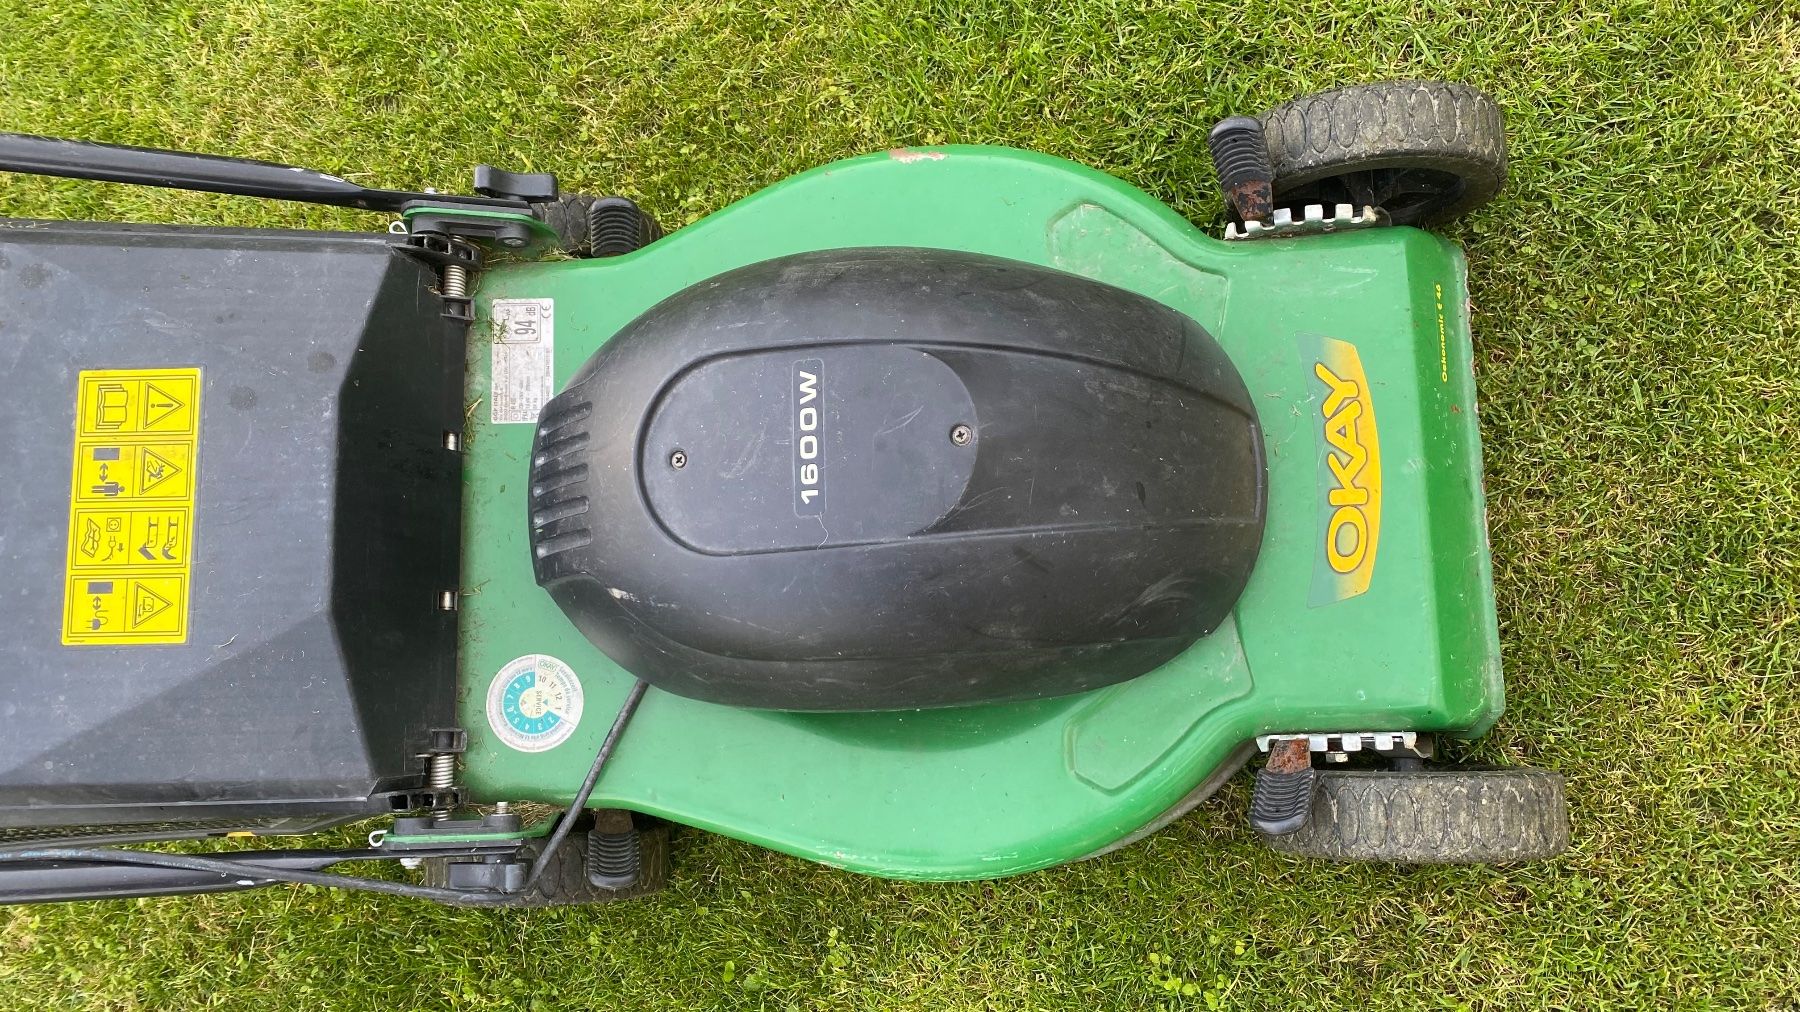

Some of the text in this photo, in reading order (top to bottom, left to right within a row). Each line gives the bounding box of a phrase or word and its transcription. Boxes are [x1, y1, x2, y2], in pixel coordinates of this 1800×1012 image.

[1435, 284, 1442, 300] 46
[513, 306, 537, 335] 94 dB
[799, 370, 819, 505] 1600W
[1315, 363, 1368, 574] OKAY
[538, 659, 558, 672] OKAY
[525, 675, 531, 683] 9
[539, 675, 547, 683] 10
[549, 681, 557, 689] 11
[535, 690, 543, 715] SERVICE
[555, 692, 562, 700] 12
[537, 722, 543, 730] 3
